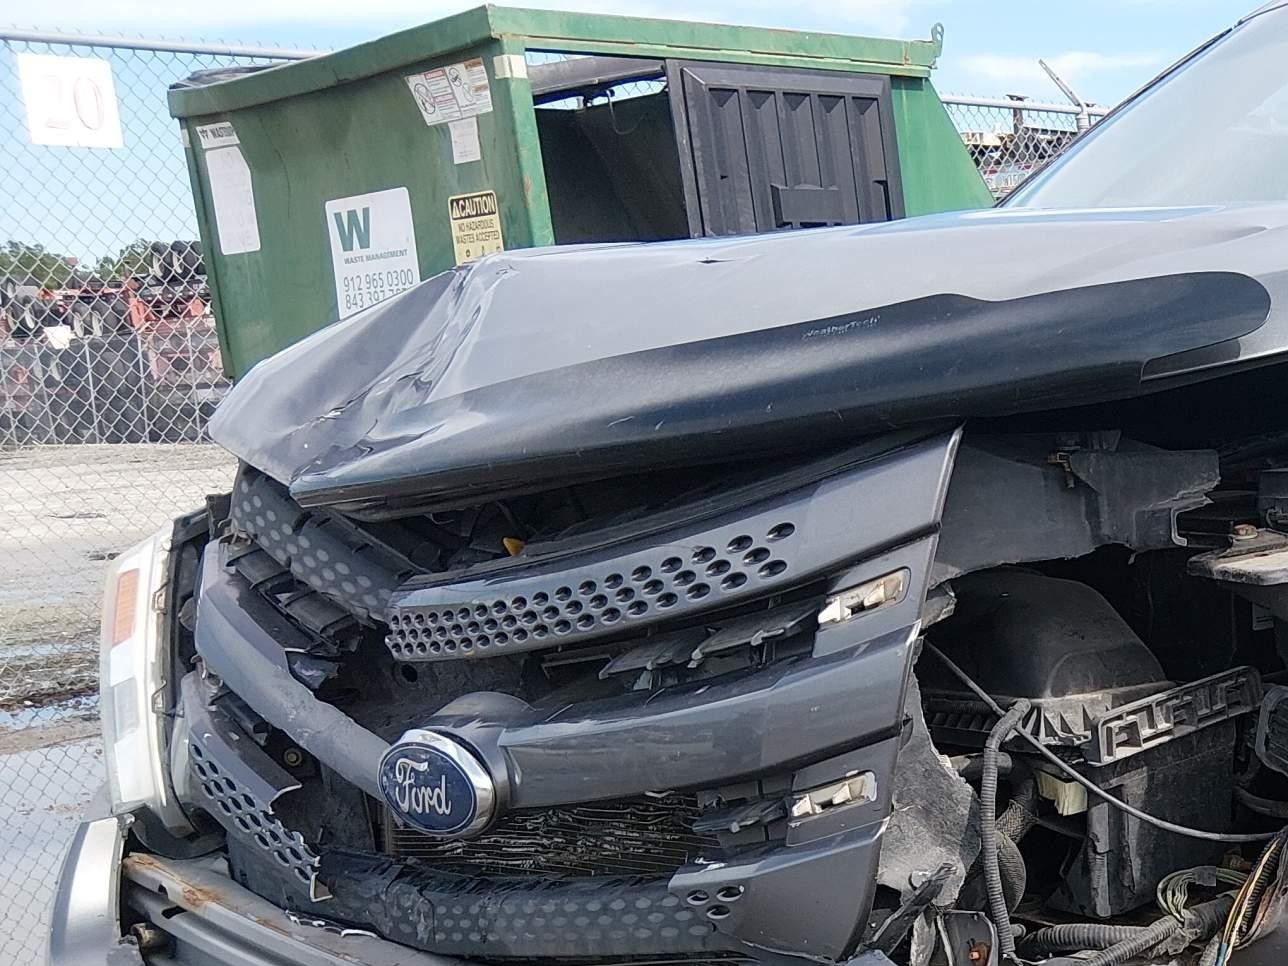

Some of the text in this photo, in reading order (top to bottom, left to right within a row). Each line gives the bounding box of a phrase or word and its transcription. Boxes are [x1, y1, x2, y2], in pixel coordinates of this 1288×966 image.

[458, 195, 496, 217] CAUTION
[333, 206, 371, 253] W
[457, 219, 495, 232] NO HAZARDOUS
[456, 230, 500, 244] WASTES ACCEPTED
[343, 248, 408, 265] WASTE MANAGEMENT
[343, 268, 414, 293] 912 965 0300
[345, 292, 364, 310] 843
[393, 757, 452, 815] Ford
